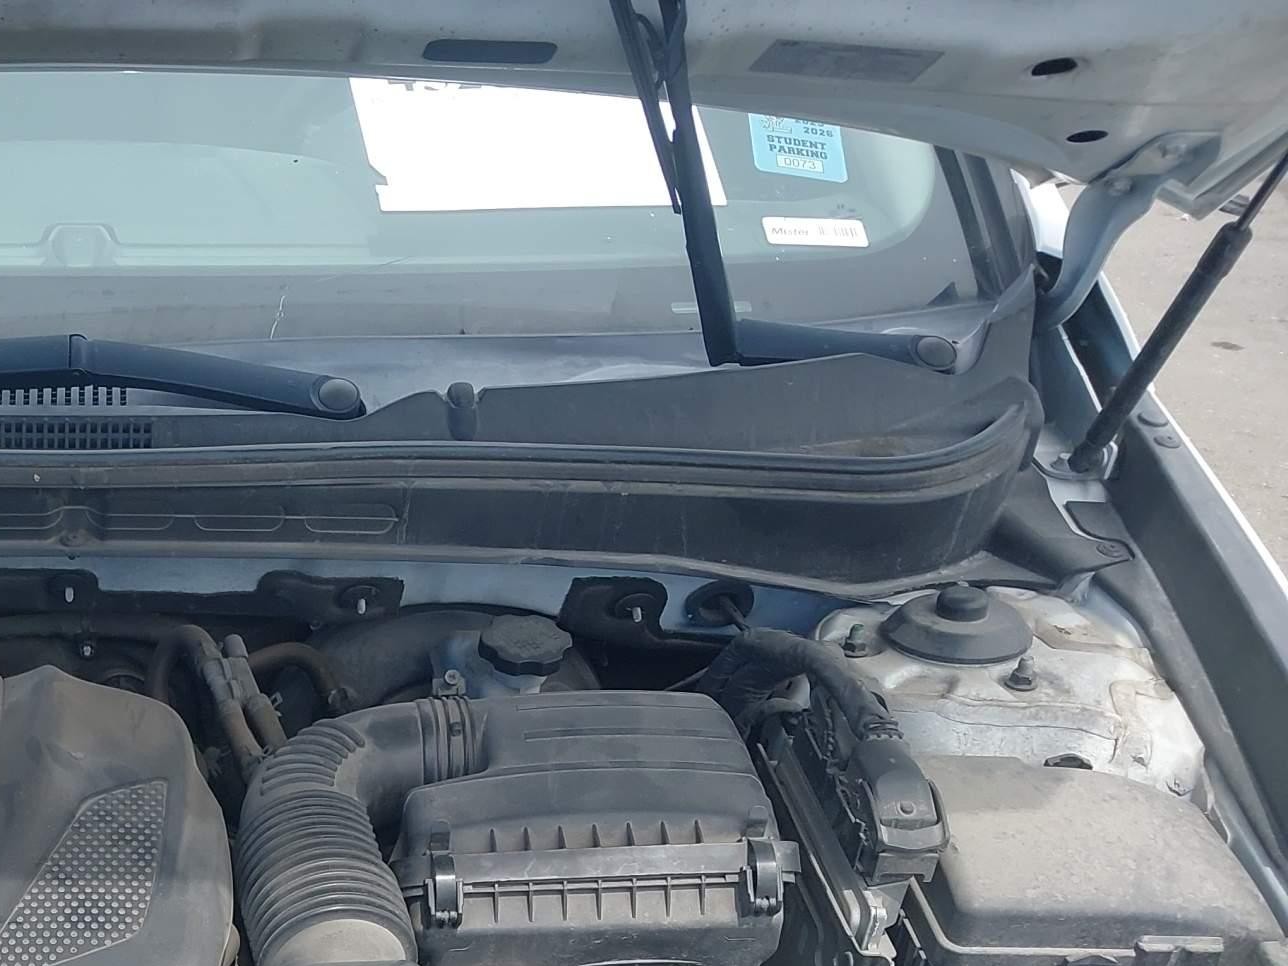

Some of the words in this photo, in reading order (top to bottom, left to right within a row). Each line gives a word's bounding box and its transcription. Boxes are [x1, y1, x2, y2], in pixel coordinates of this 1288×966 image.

[803, 126, 834, 137] 2026
[766, 134, 827, 151] STUDENT
[769, 144, 829, 161] PARKING
[783, 157, 818, 169] 0073
